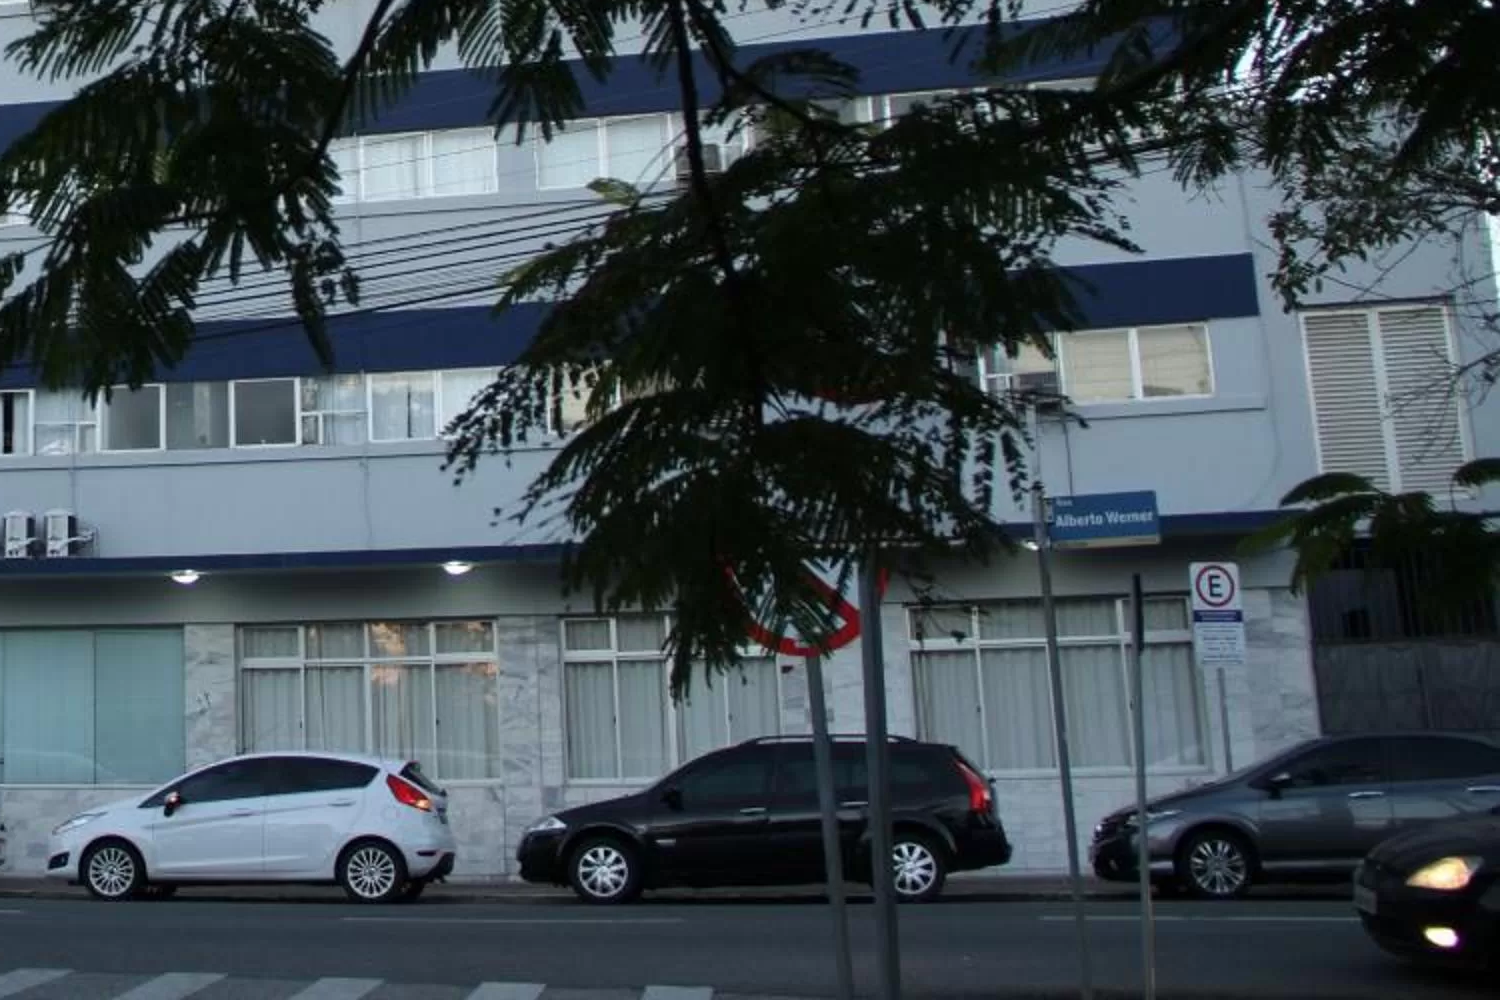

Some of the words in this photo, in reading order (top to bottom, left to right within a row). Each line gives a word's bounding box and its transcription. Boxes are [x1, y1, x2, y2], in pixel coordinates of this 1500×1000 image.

[1055, 512, 1104, 528] Alberto
[1105, 510, 1153, 525] Werner
[1208, 575, 1223, 597] E
